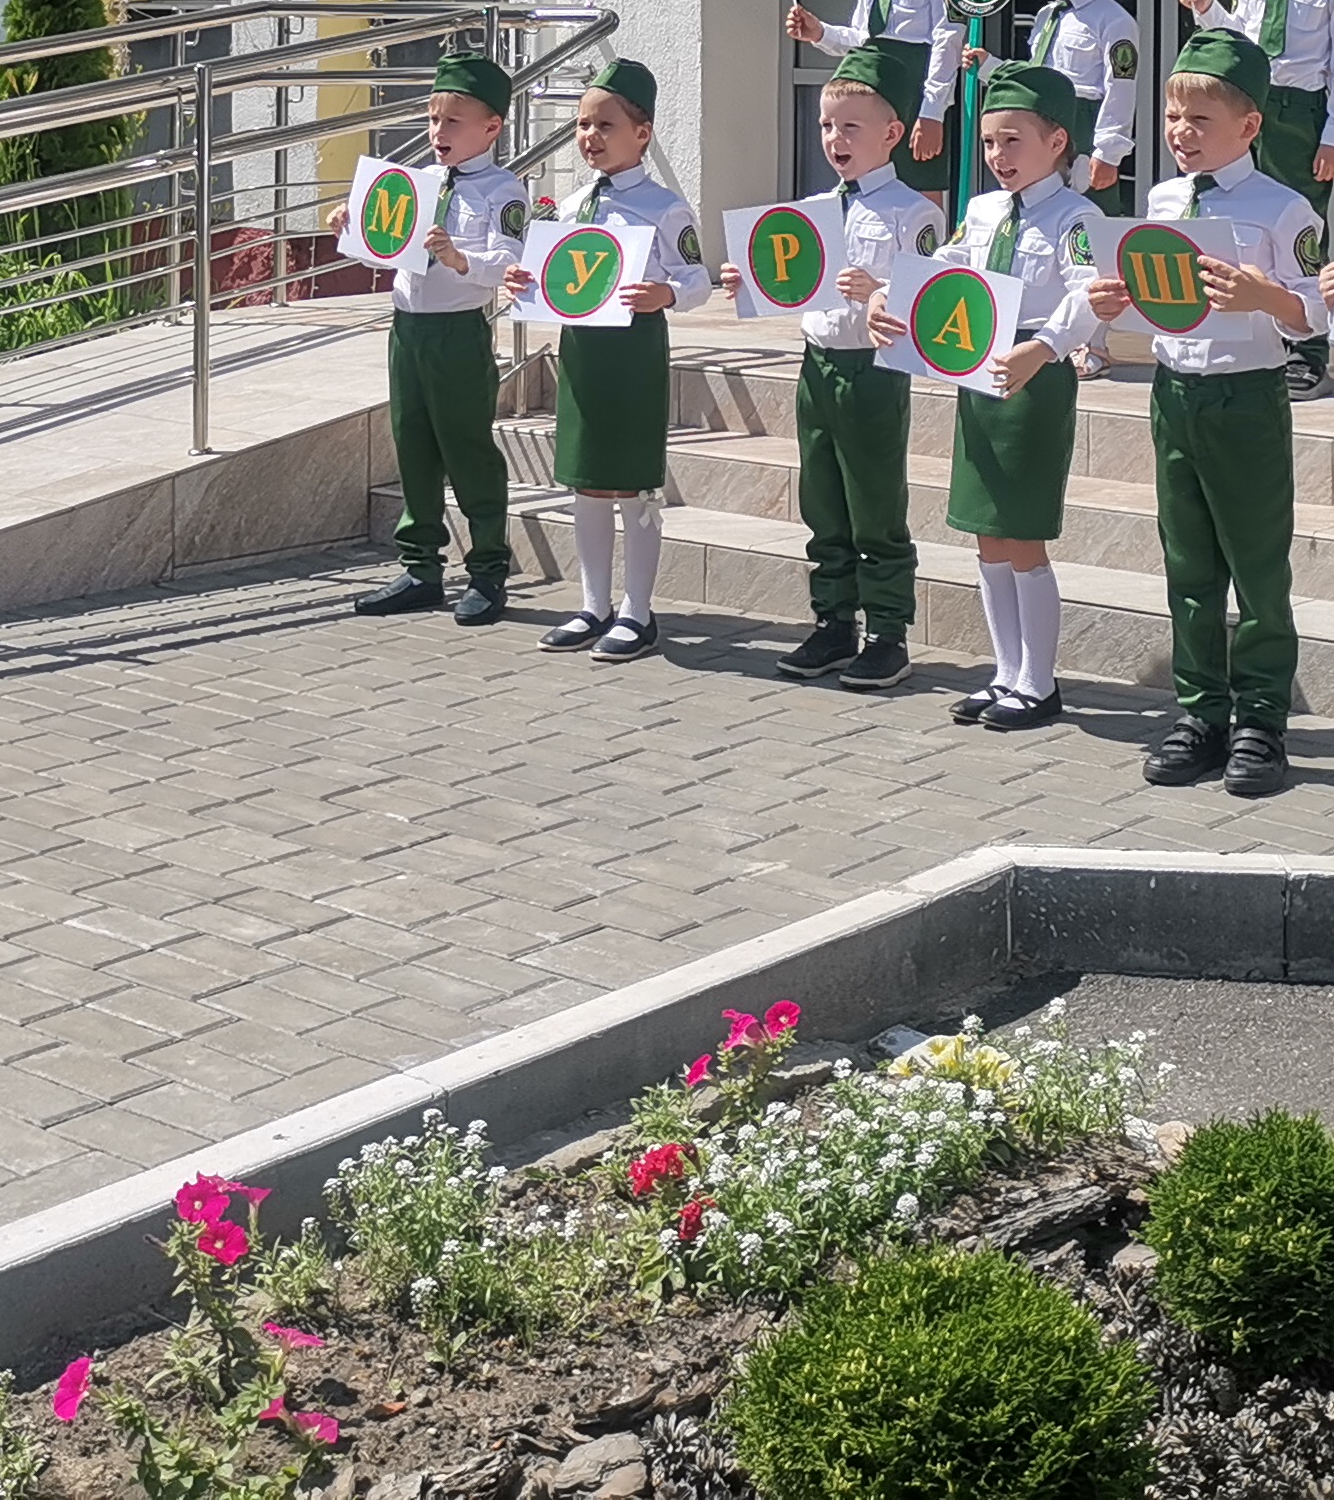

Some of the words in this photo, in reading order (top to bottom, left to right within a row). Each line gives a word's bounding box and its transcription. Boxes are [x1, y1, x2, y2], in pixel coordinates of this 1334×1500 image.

[365, 187, 413, 240] М
[564, 249, 608, 296] У
[768, 233, 800, 283] Р
[1127, 251, 1200, 305] Ш
[931, 296, 976, 353] А
